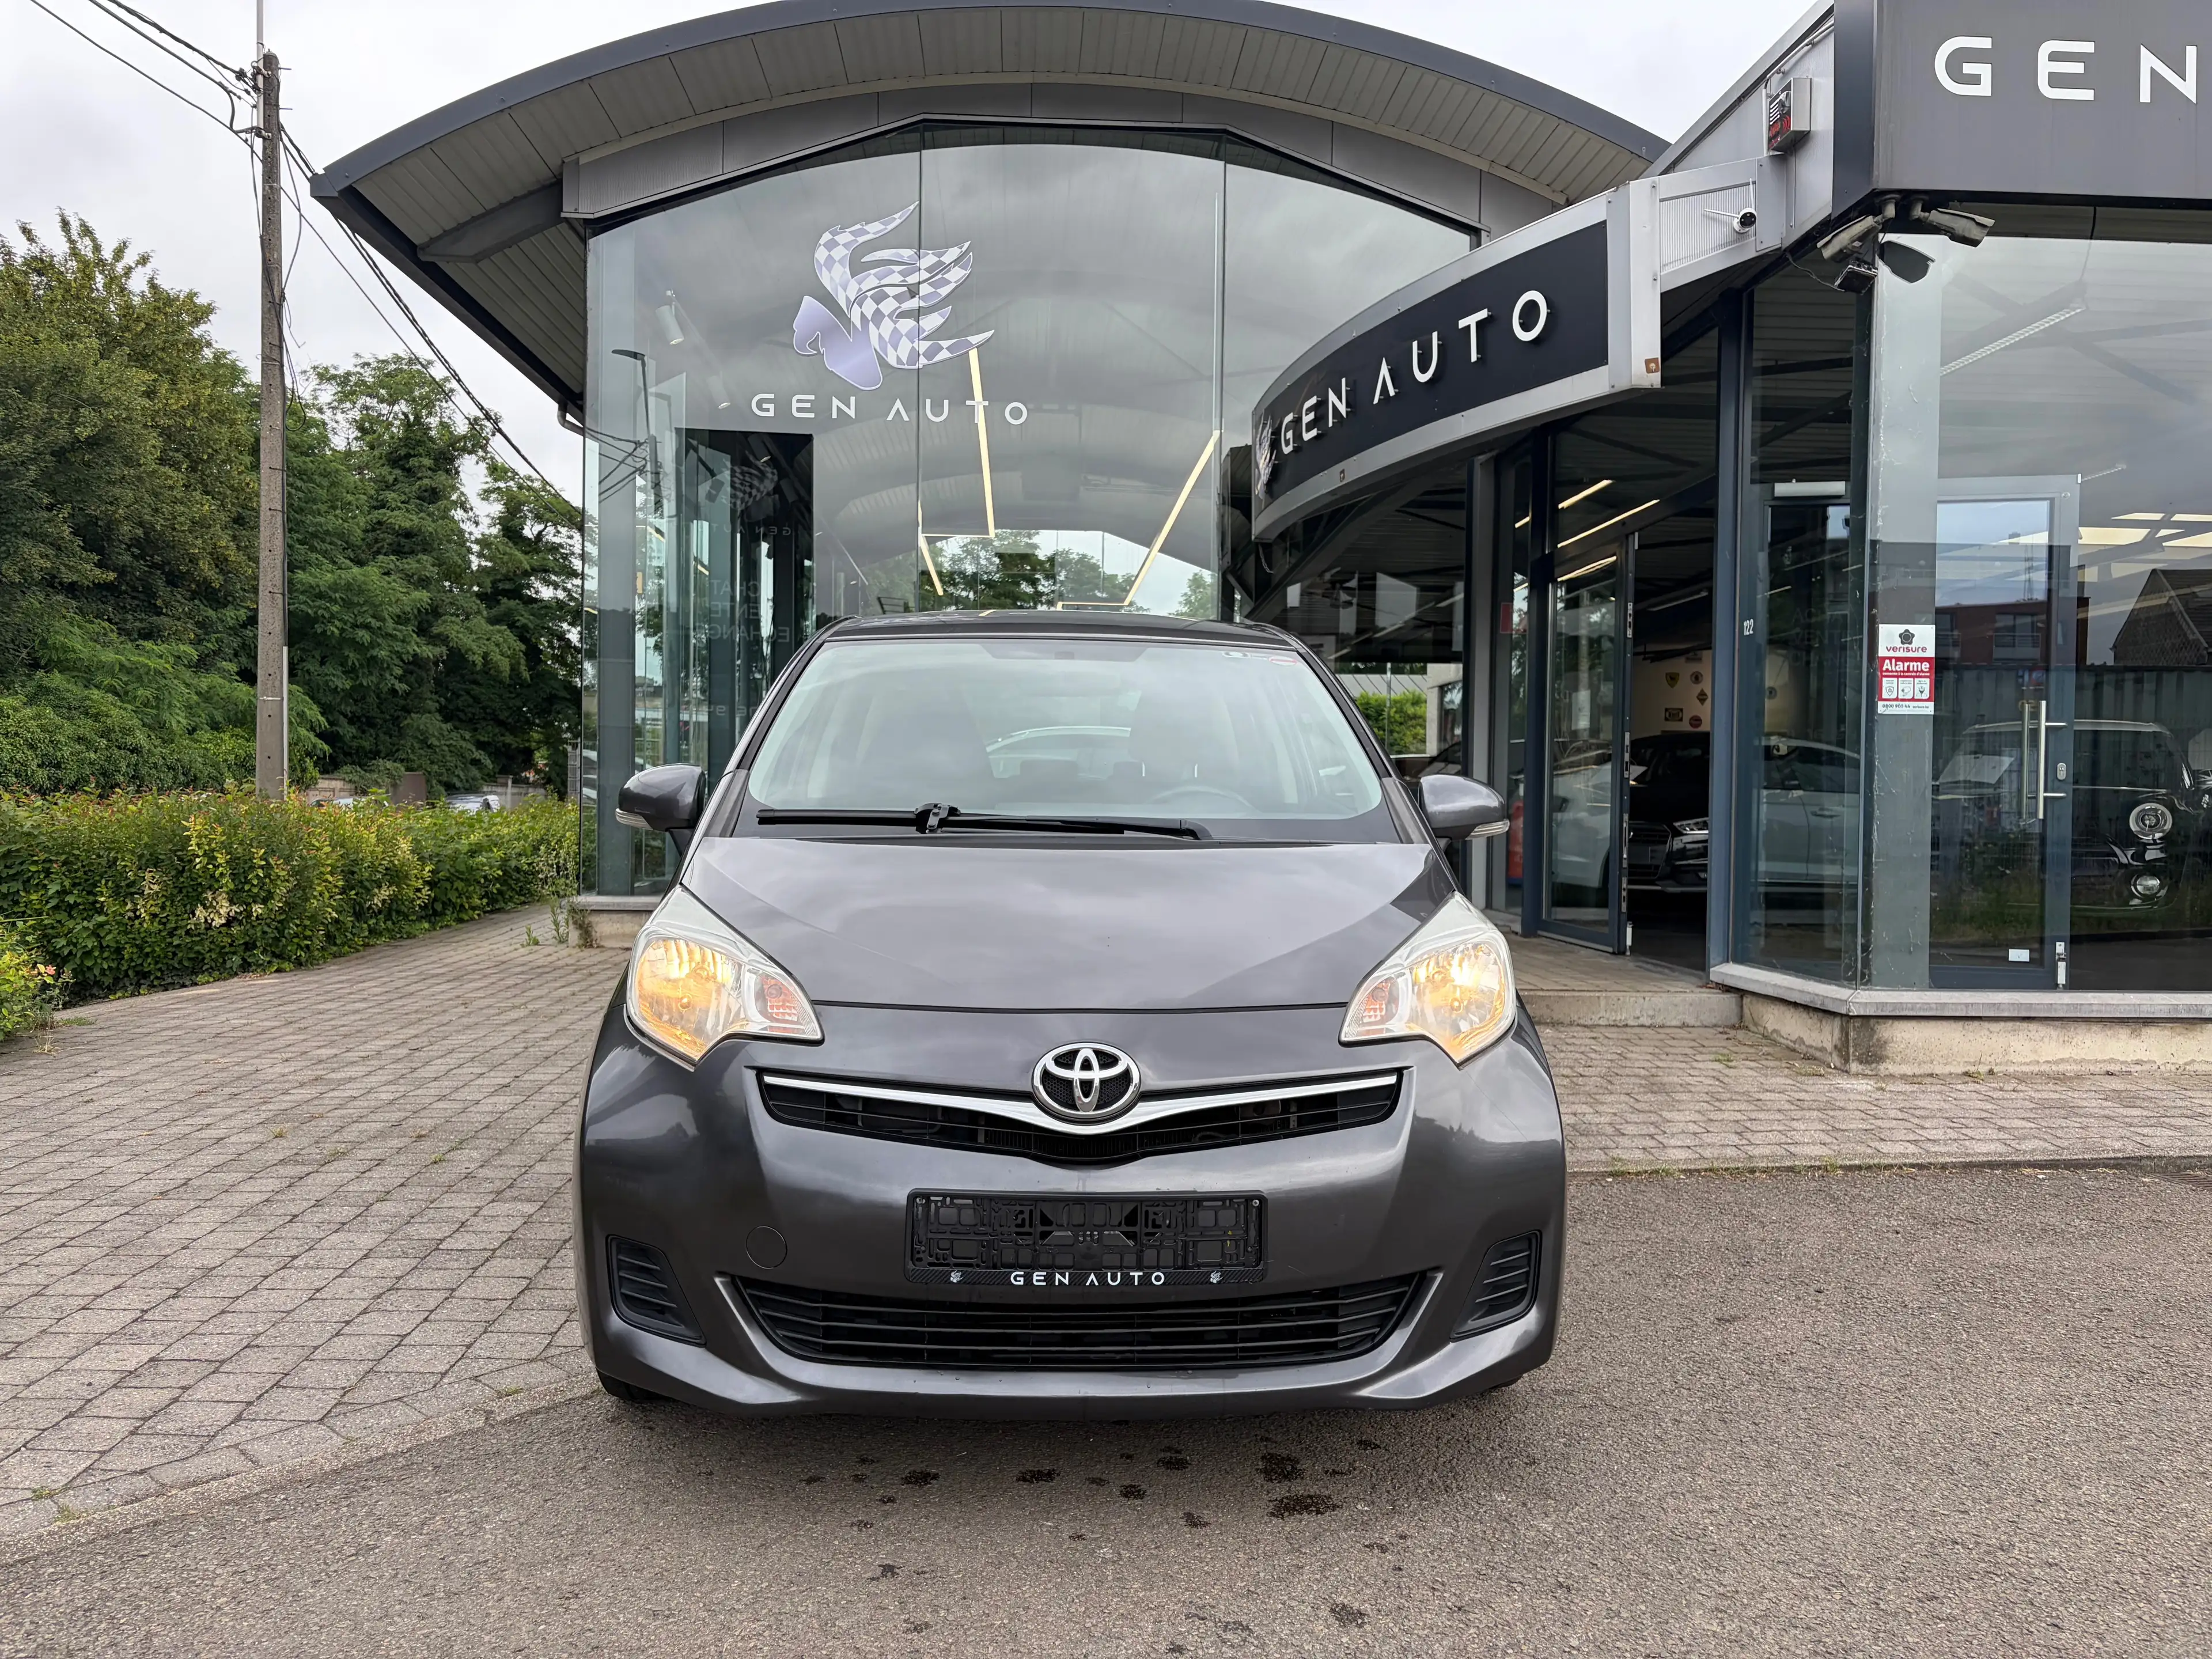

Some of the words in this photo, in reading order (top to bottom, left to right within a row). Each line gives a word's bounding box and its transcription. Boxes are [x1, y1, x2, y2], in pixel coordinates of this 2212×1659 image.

[1934, 36, 2198, 104] GEN
[1281, 377, 1346, 454] GEN
[1373, 290, 1547, 404] AUTO
[751, 393, 855, 419] GEN
[886, 398, 1028, 425] AUTO
[1744, 618, 1754, 636] 122
[1883, 658, 1930, 672] Alarme
[1010, 1271, 1069, 1285] GEN
[1086, 1272, 1165, 1286] AUTO
